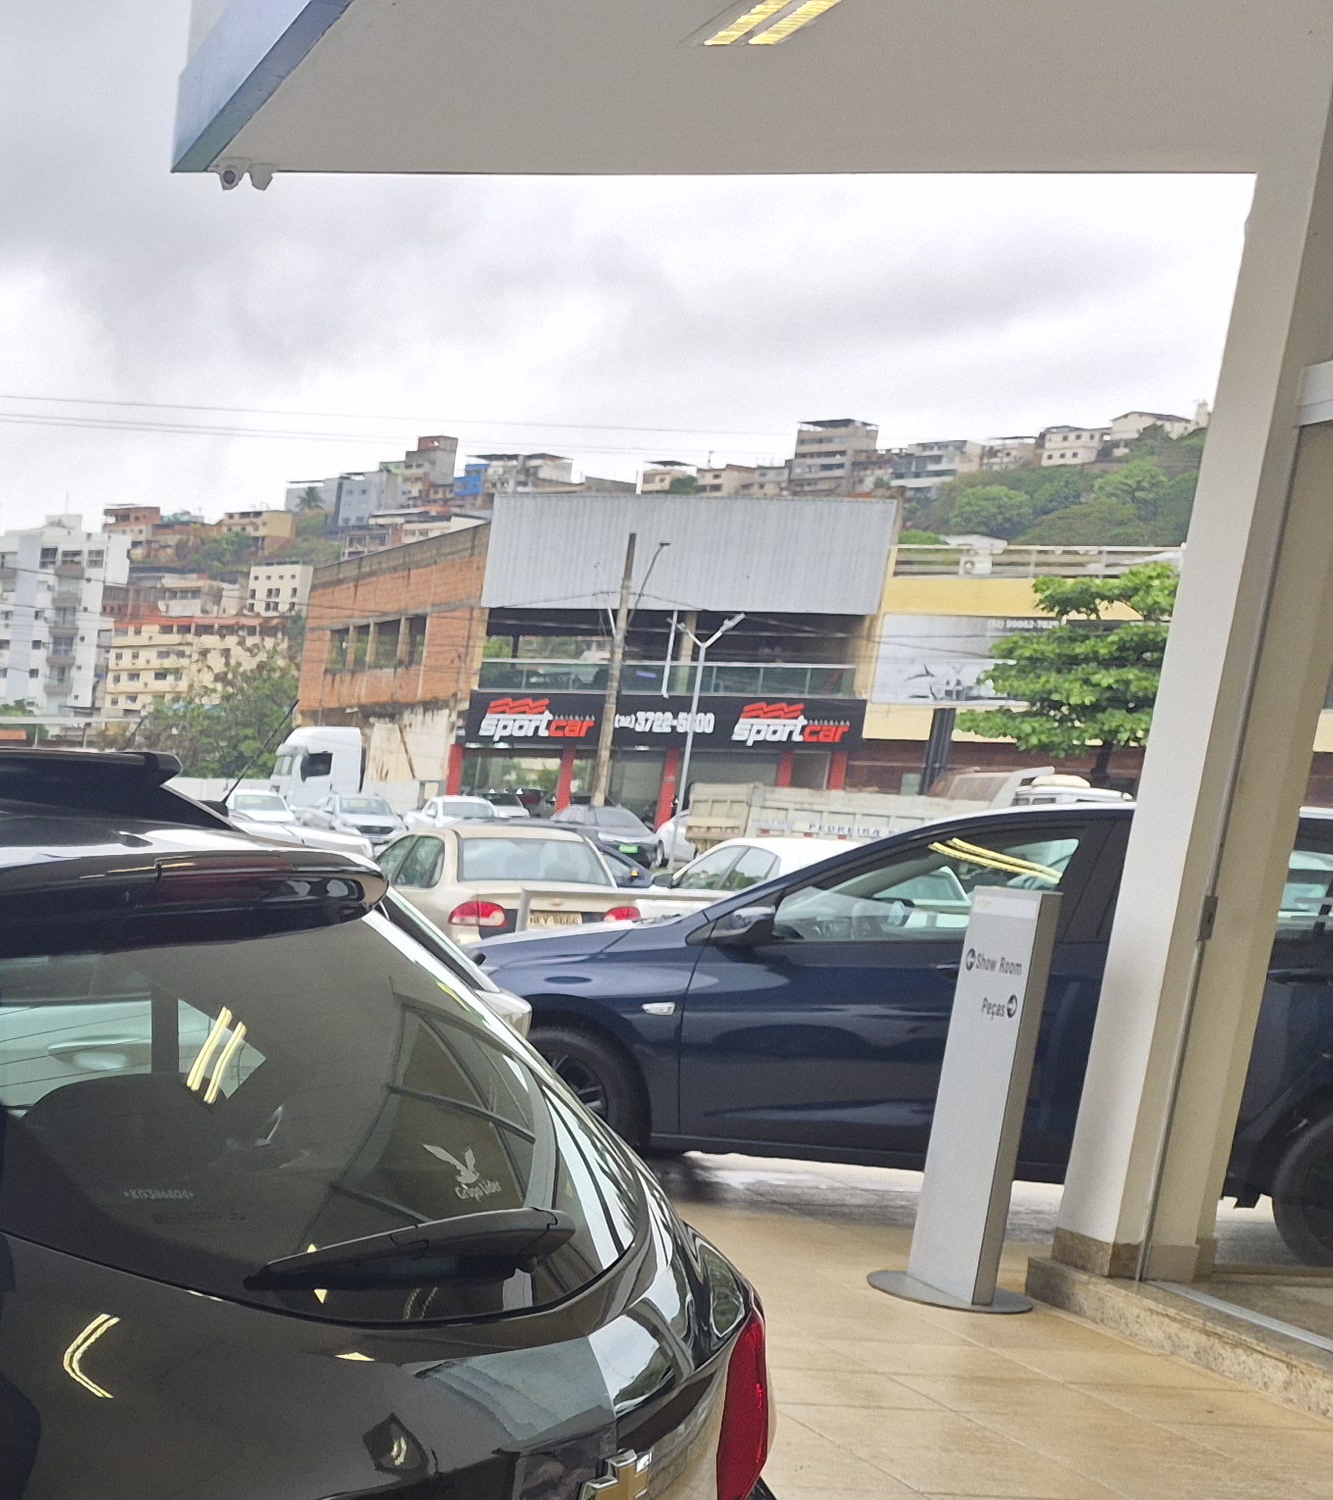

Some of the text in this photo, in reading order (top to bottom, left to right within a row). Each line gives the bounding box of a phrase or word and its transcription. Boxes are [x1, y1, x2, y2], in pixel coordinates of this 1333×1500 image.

[975, 953, 1023, 976] Show Room
[981, 997, 1005, 1020] Peças
